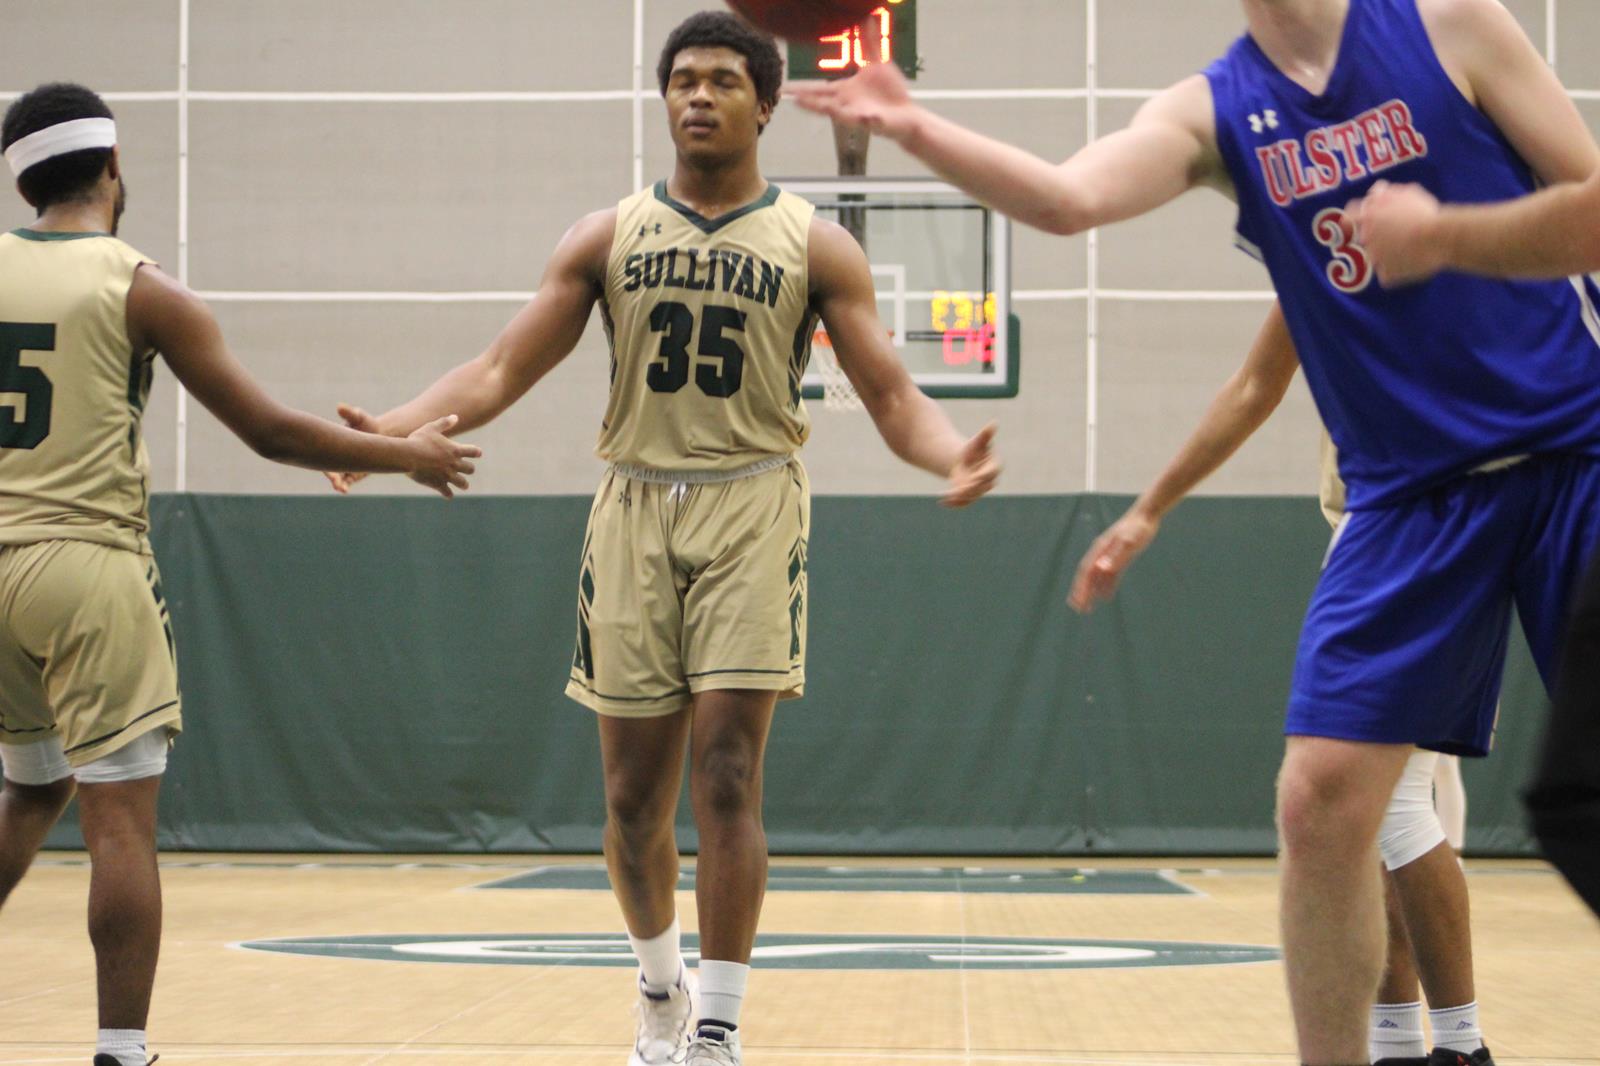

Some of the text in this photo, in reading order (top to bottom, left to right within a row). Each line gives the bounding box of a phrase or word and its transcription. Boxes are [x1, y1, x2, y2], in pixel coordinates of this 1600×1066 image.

[1255, 99, 1427, 207] ULSTER
[624, 247, 784, 308] SULLIVAN
[0, 321, 56, 450] 5
[646, 301, 747, 398] 35
